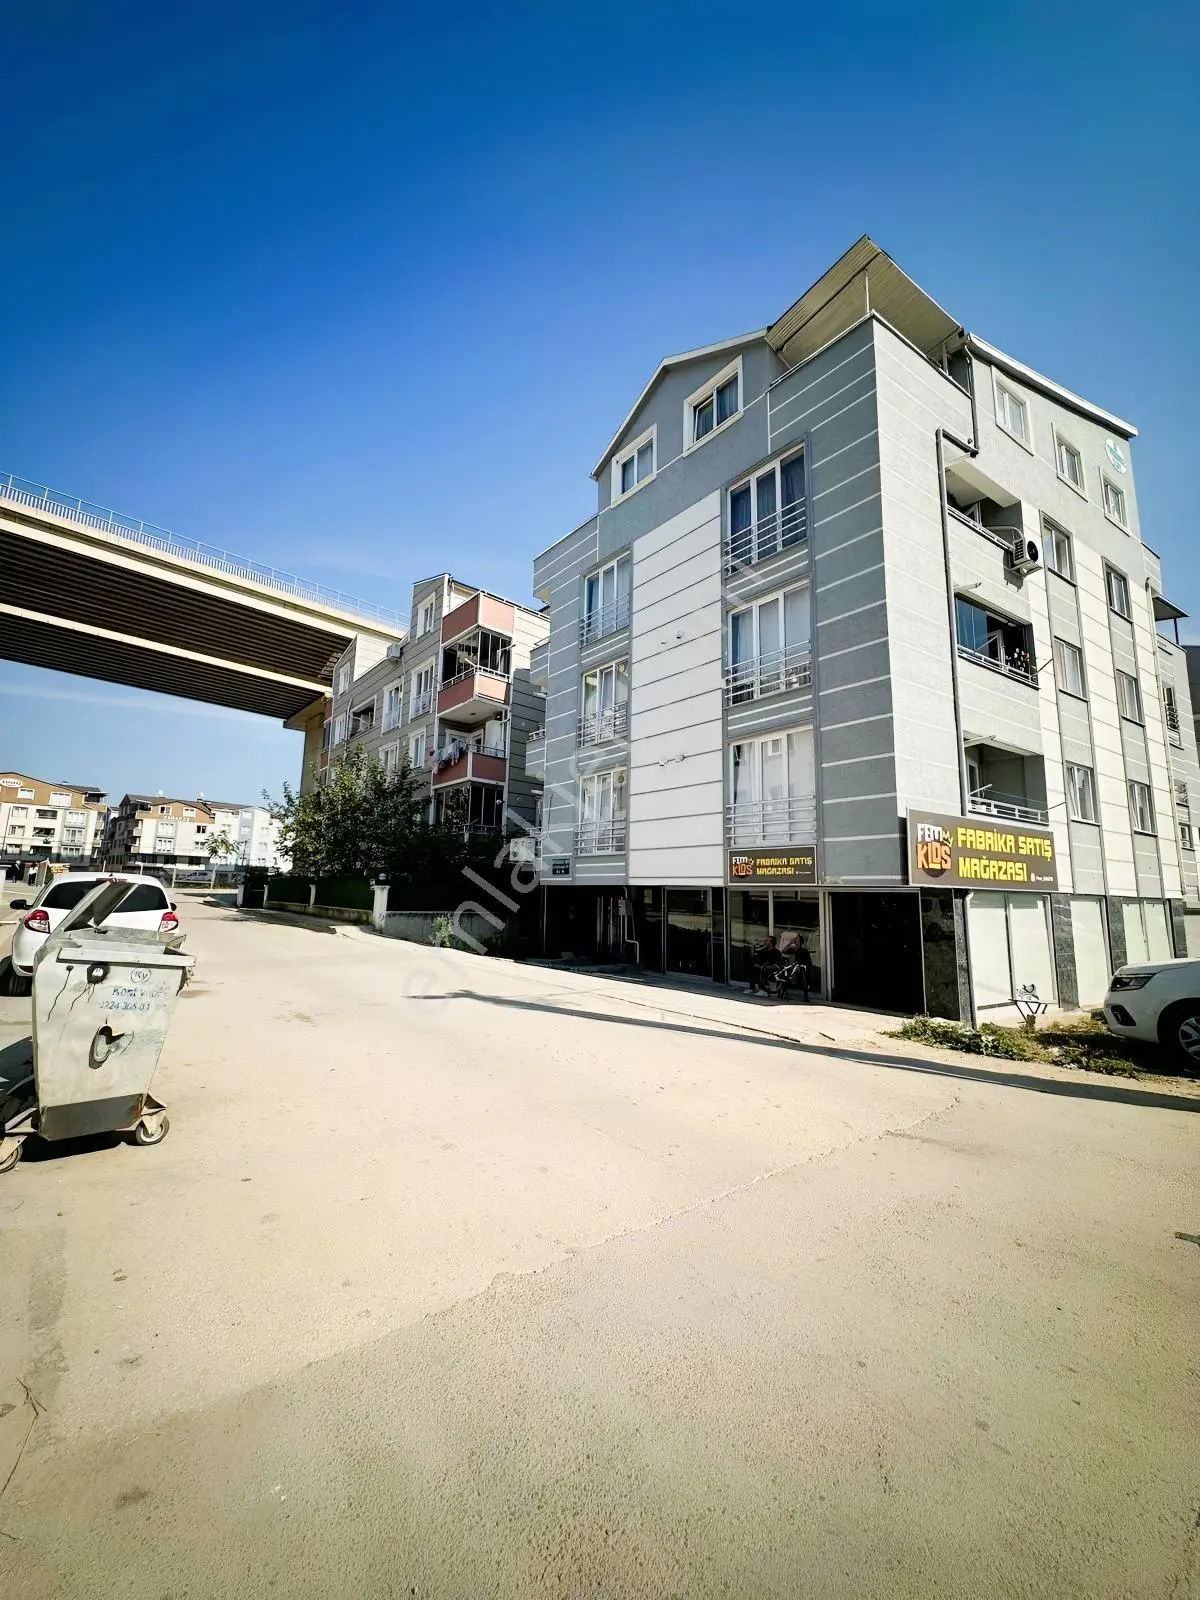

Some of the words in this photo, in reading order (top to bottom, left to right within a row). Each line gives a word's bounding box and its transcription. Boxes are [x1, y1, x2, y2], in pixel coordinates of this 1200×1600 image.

[957, 827, 1015, 853] FABRİKA
[1018, 836, 1052, 861] SATIŞ
[958, 855, 1027, 882] MAĞAZASI
